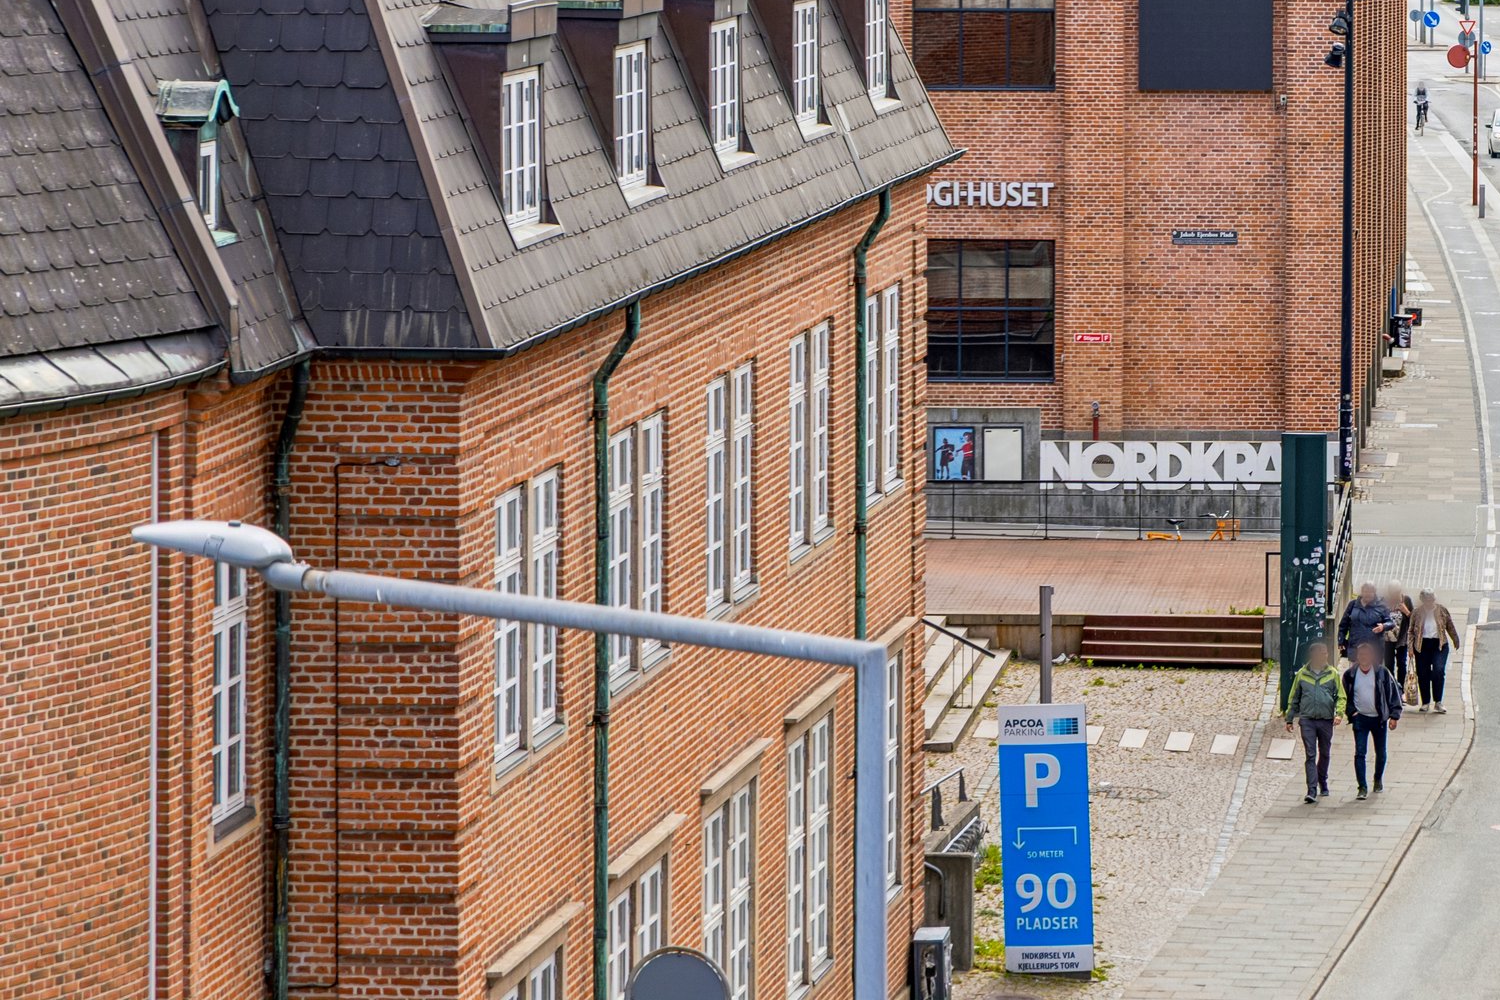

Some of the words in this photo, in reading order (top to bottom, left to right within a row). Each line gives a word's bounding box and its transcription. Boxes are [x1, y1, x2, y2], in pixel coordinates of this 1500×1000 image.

[1179, 231, 1196, 239] Jakob
[1040, 441, 1341, 491] NORDKRA
[1004, 717, 1044, 728] APCOA
[1004, 727, 1045, 737] PARKING
[1023, 752, 1061, 808] P
[1026, 850, 1038, 859] 50
[1038, 849, 1064, 859] METER
[1015, 872, 1077, 914] 90
[1016, 916, 1079, 931] PLADSER
[1021, 951, 1062, 961] INDKØRSEL
[1062, 950, 1076, 960] VIA
[1017, 961, 1060, 971] KJELLERUPS
[1060, 961, 1080, 970] TORV
